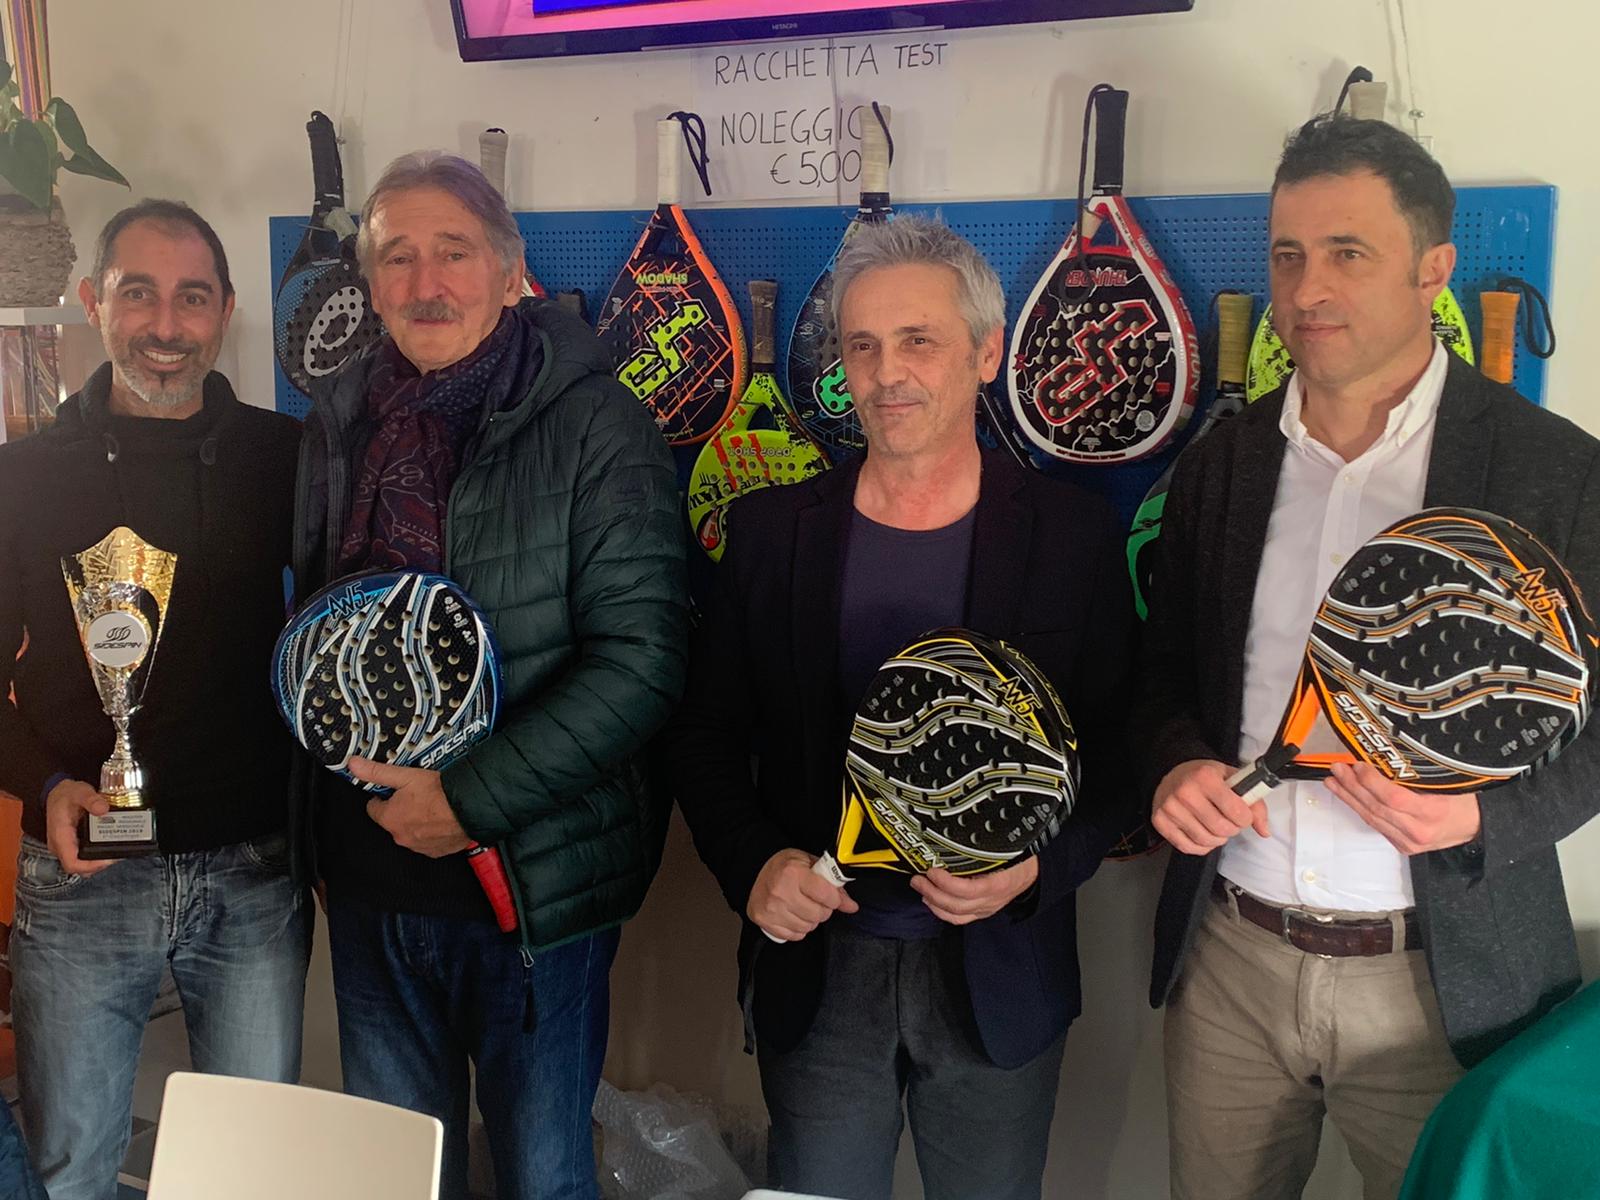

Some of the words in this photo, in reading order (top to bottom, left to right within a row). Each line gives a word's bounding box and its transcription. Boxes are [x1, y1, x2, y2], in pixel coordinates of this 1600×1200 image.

[715, 44, 879, 85] RACCHETTA
[894, 42, 949, 69] TEST
[770, 153, 791, 184] €
[799, 149, 862, 188] 5,00
[636, 272, 688, 286] SHADOW
[761, 447, 791, 457] DROP
[327, 581, 367, 620] AW5
[1512, 566, 1568, 614] AW5
[1000, 676, 1043, 716] AW5
[420, 713, 490, 770] SIDESPIN
[1334, 694, 1416, 778] SIDESPIN
[873, 799, 945, 868] SIDESPIN
